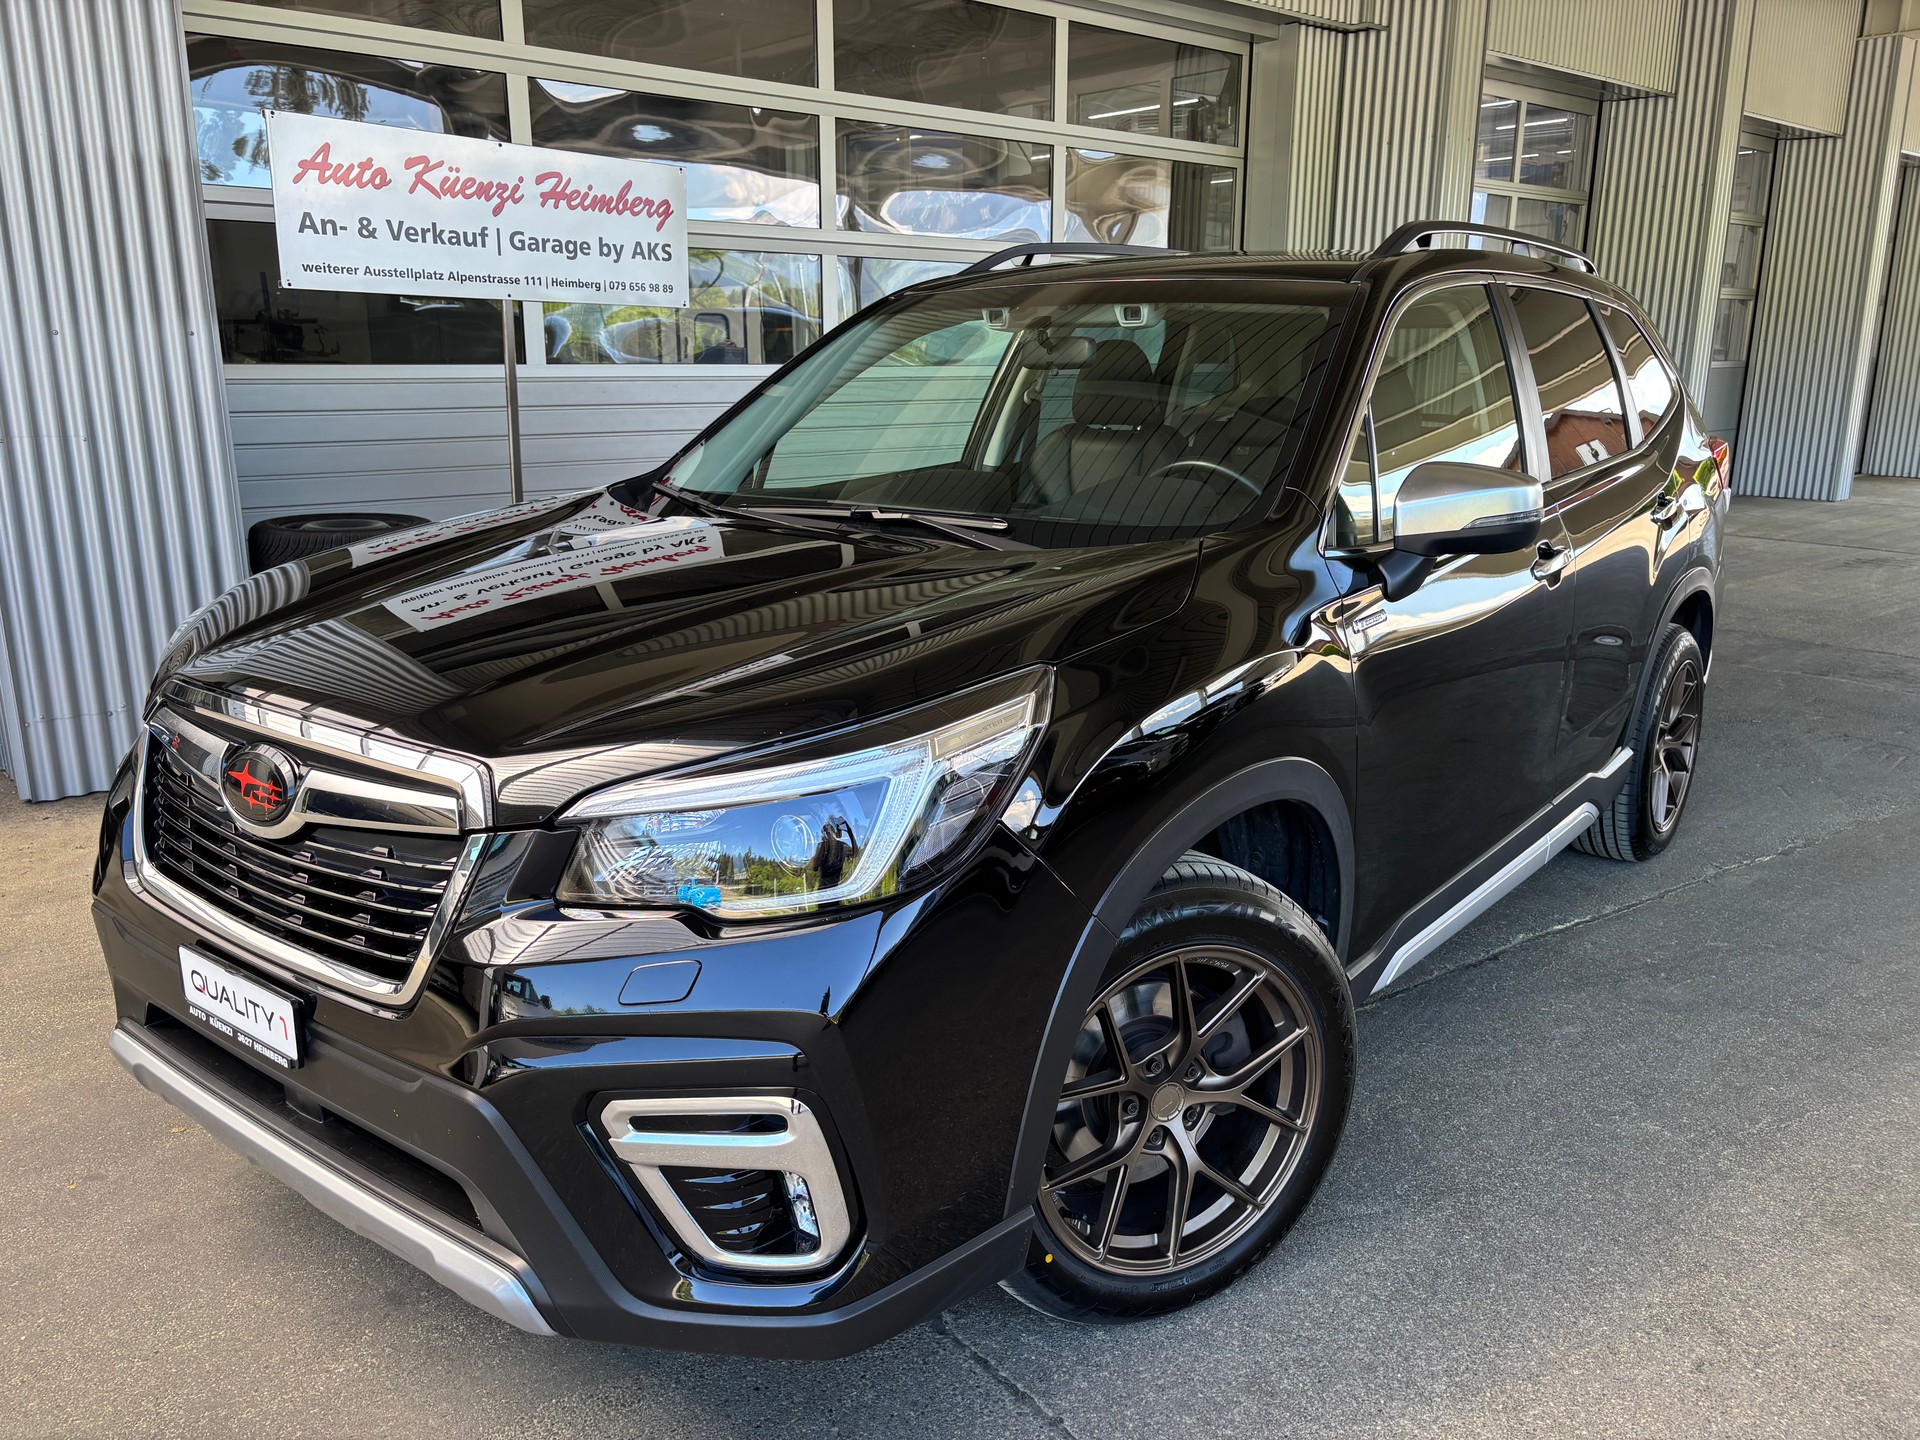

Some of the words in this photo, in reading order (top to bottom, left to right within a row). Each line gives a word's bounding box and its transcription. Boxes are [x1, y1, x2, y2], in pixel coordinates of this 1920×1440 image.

[292, 142, 392, 190] Auto
[404, 155, 525, 217] Küenzi
[535, 171, 674, 232] Heimberg
[298, 211, 348, 236] An-
[357, 216, 378, 240] &
[385, 218, 489, 248] Verkauf
[509, 230, 591, 260] Garage
[598, 236, 625, 263] by
[631, 241, 673, 262] AKS
[302, 262, 360, 276] weiterer
[363, 265, 444, 283] Ausstellplatz
[447, 271, 521, 286] Alpenstrasse
[524, 275, 543, 287] 111
[551, 277, 601, 292] Heimberg
[609, 280, 627, 292] 079
[629, 282, 647, 293] 656
[649, 283, 660, 293] 98
[662, 284, 674, 294] 89
[191, 969, 275, 1031] QUALITY
[189, 1005, 207, 1021] AUTO
[209, 1016, 233, 1037] KÜENZI
[253, 1041, 289, 1069] HEIMBERG
